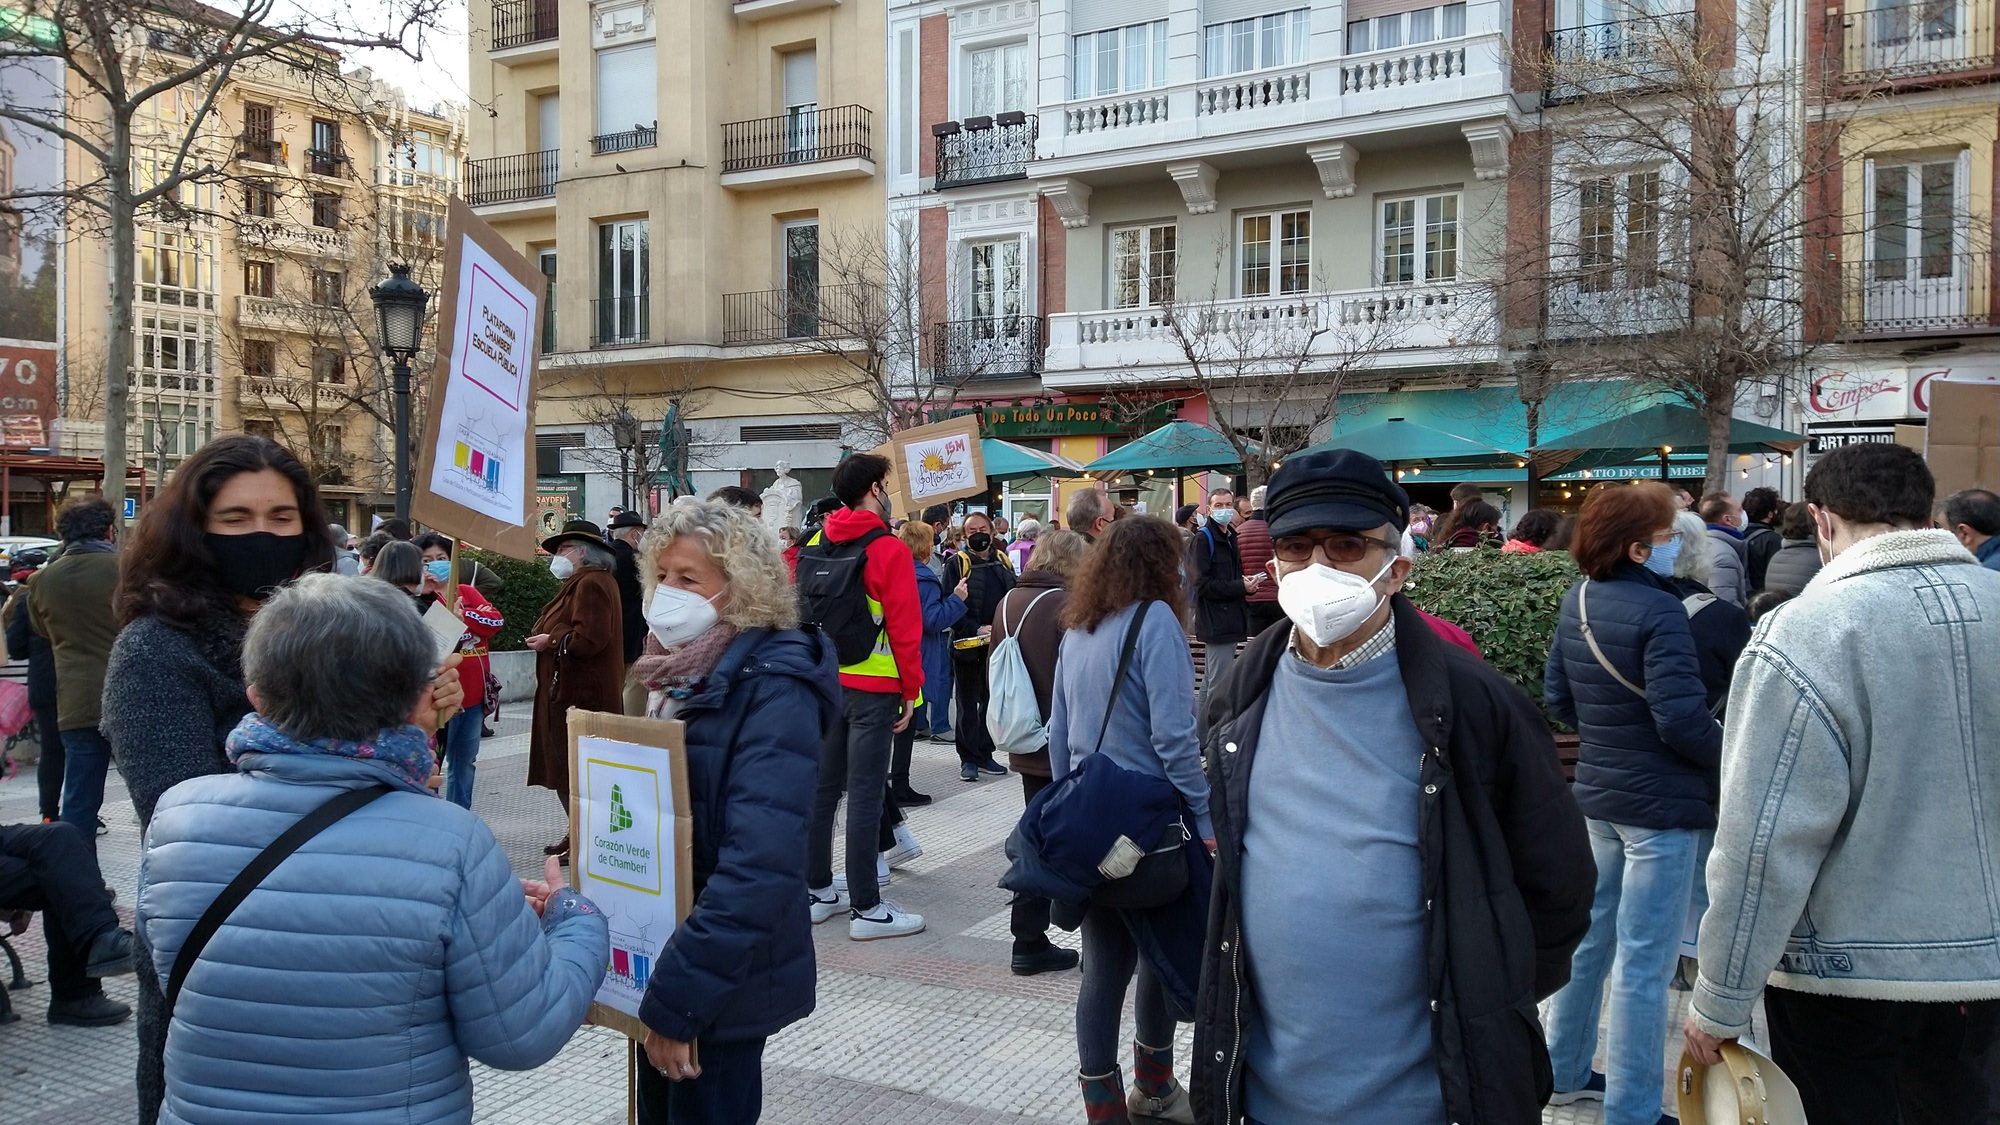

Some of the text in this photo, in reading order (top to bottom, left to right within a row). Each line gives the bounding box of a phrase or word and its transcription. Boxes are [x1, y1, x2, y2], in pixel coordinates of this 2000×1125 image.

[482, 304, 516, 343] PLATAFORMA
[472, 332, 518, 378] ESCUELA PÚBLICA
[991, 407, 1097, 424] De Todo Un Poco
[944, 439, 965, 455] 15M
[1818, 435, 1845, 451] ART
[1619, 468, 1637, 478] DE
[536, 496, 565, 504] RAYDEN
[594, 835, 651, 859] Corazón Verde
[598, 853, 608, 864] de
